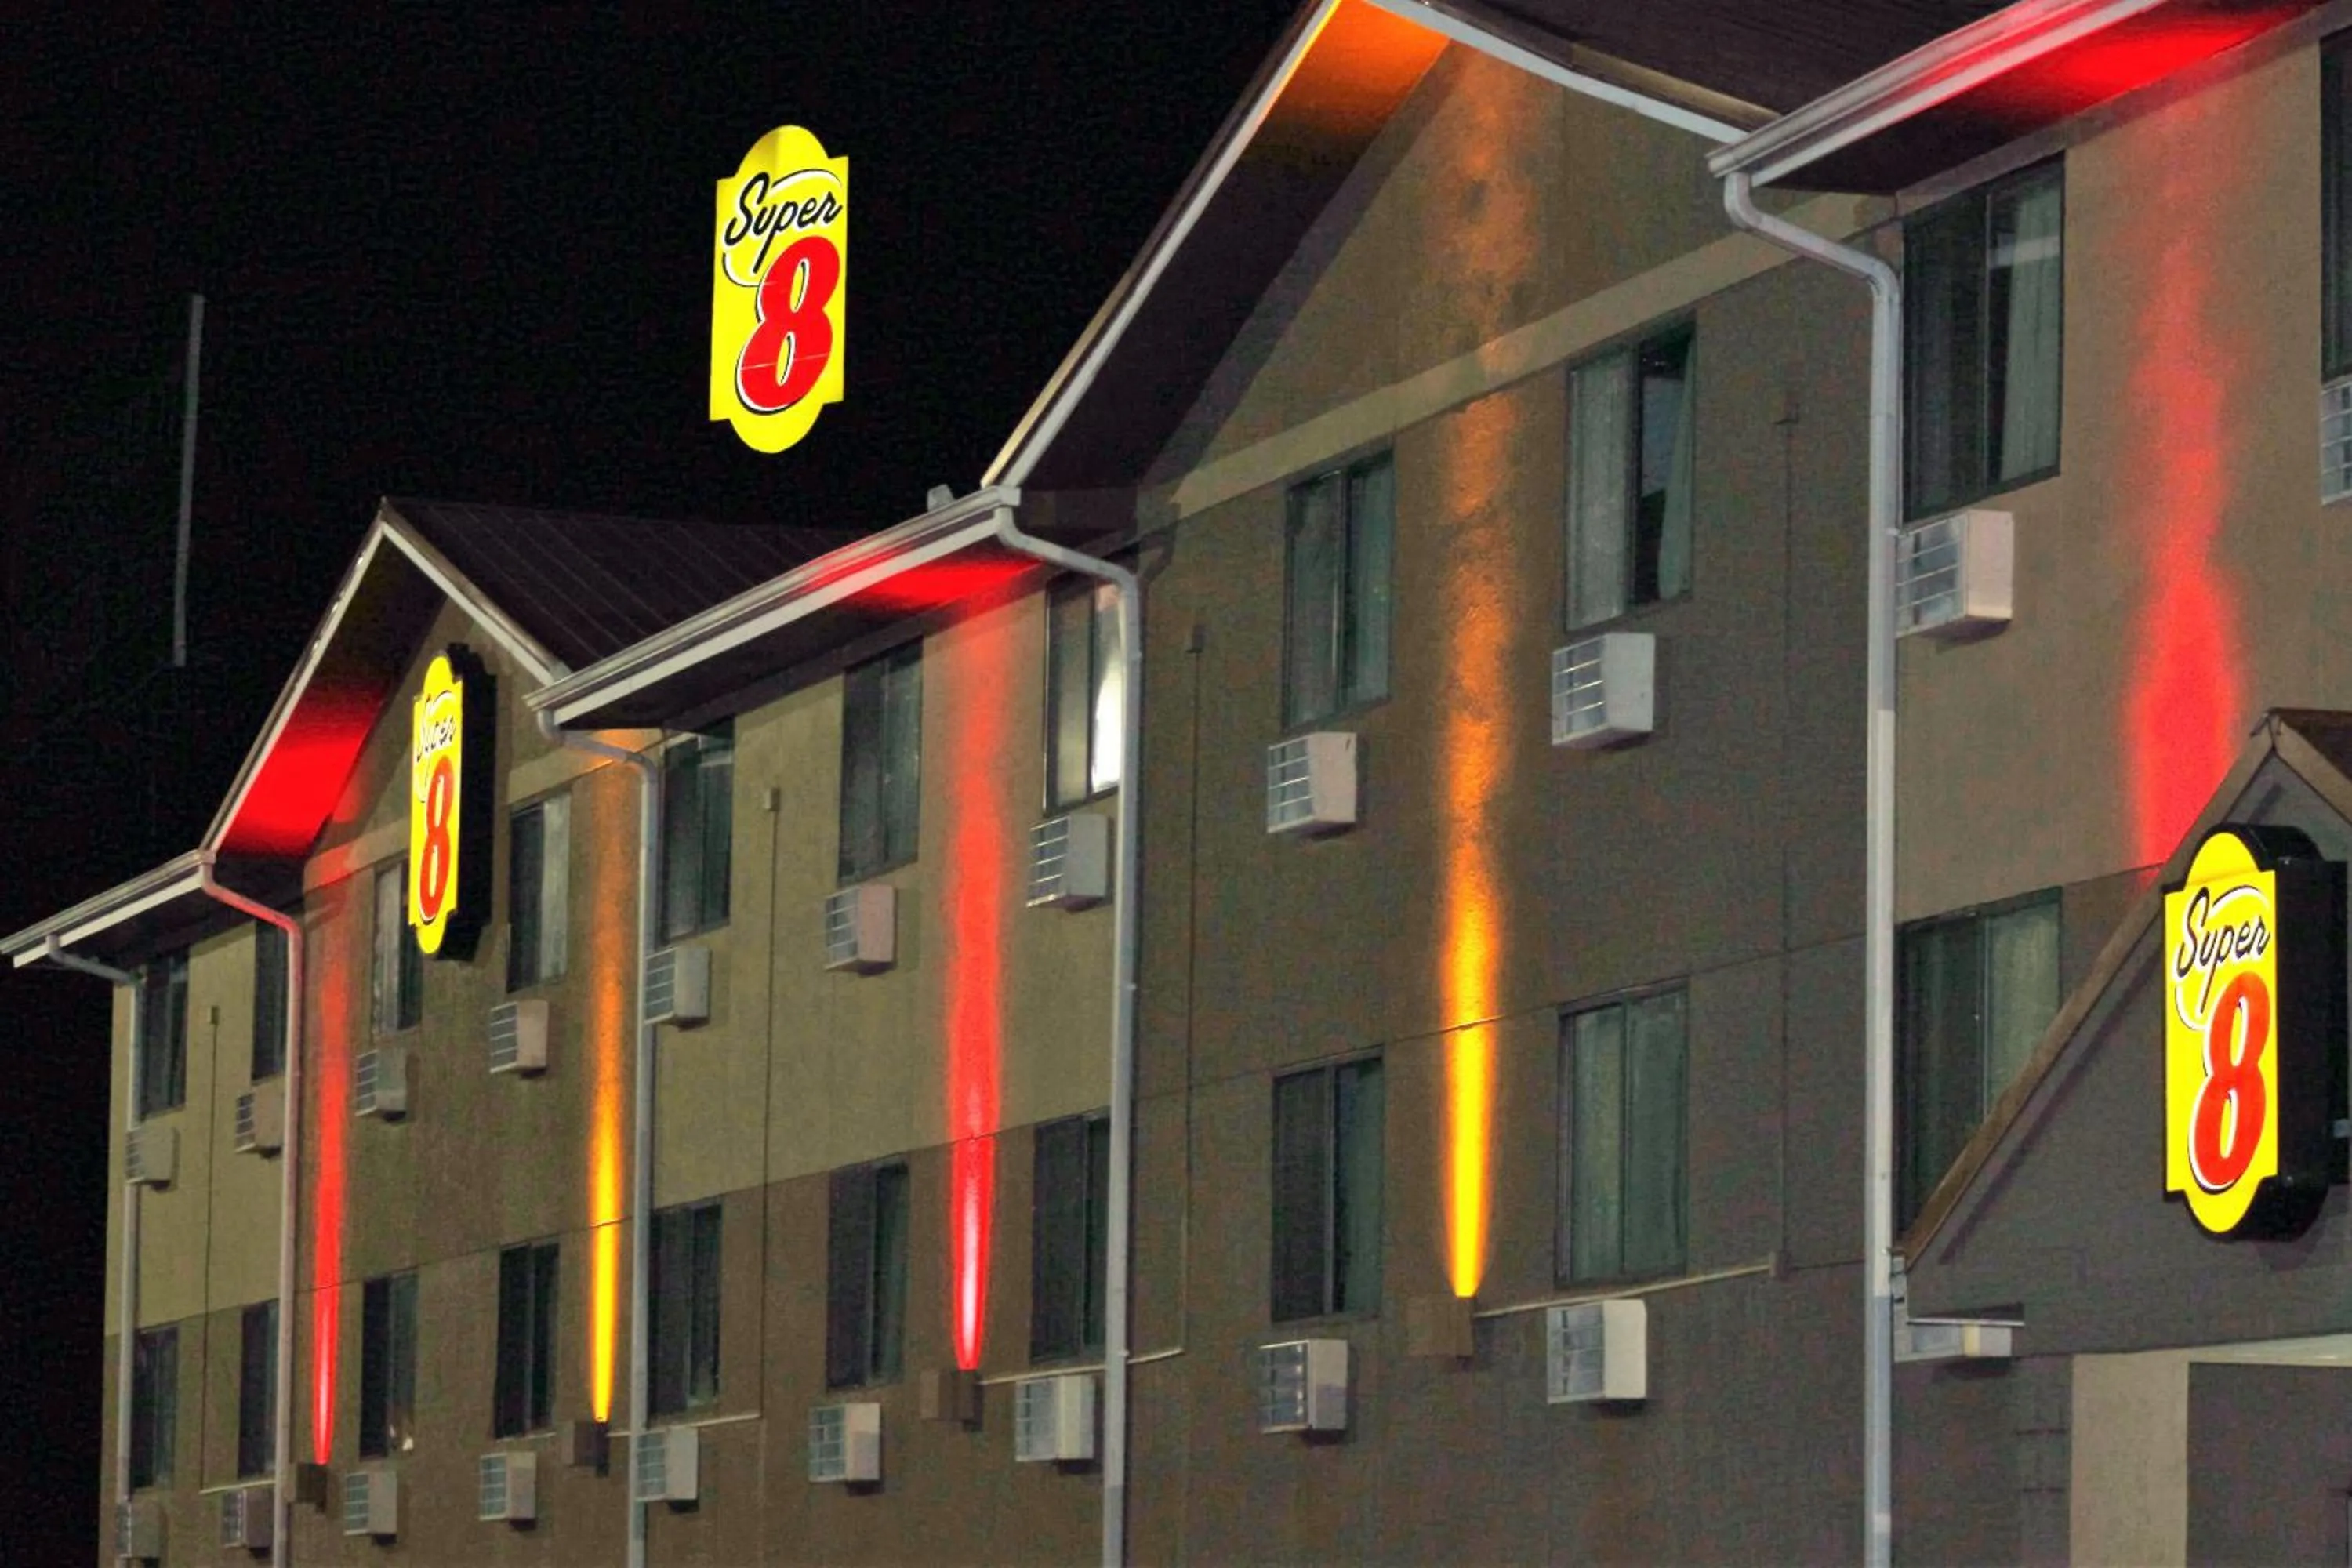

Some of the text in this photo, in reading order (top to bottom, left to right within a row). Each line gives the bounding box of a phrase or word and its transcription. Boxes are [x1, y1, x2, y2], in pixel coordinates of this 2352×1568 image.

[724, 172, 844, 274] Super
[736, 235, 841, 416] 8
[419, 754, 455, 925] 8
[2176, 886, 2271, 1014] Super
[2189, 971, 2271, 1195] 8
